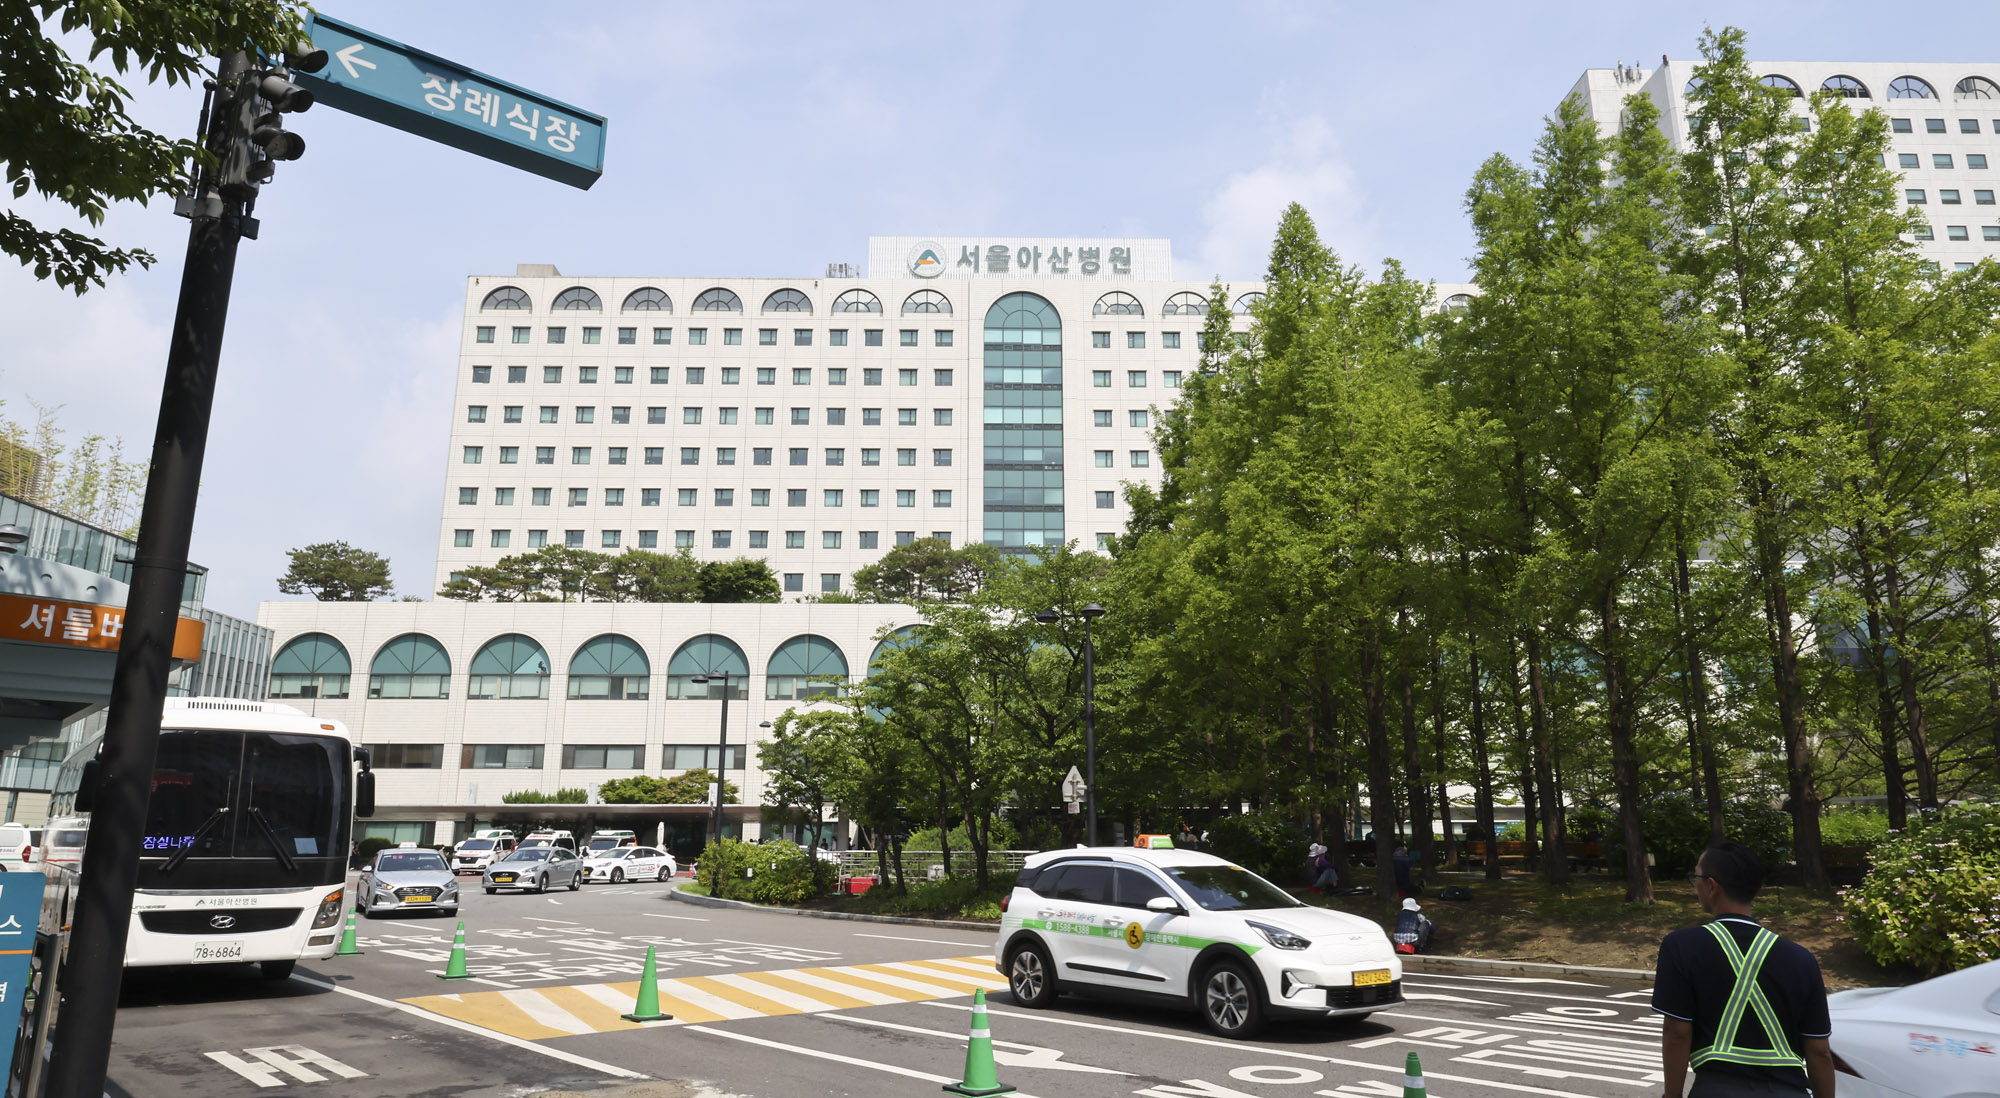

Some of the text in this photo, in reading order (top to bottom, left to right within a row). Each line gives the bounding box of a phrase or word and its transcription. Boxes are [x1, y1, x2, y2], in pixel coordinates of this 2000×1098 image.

[421, 72, 581, 153] 장례식장
[957, 245, 1131, 274] 서울아산병원
[20, 604, 124, 641] 셔틀버
[208, 897, 258, 906] 서울아산병원
[195, 946, 241, 959] 78수6864
